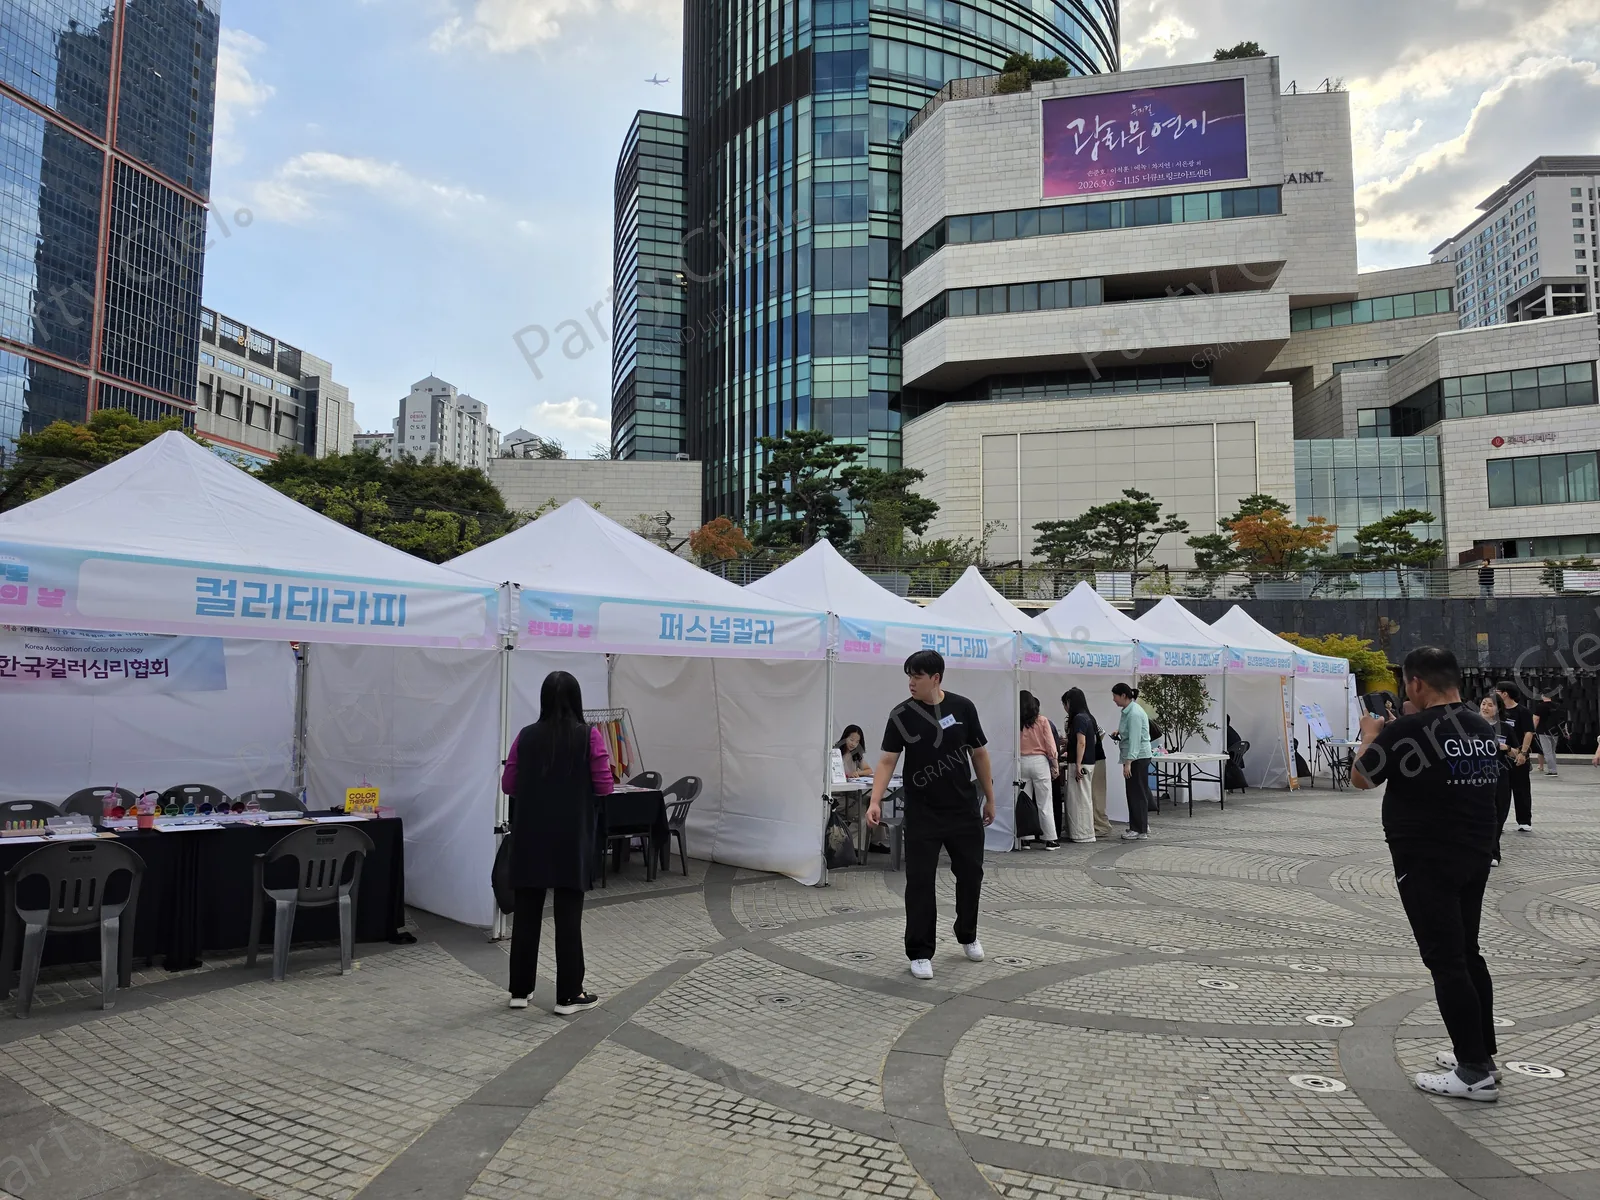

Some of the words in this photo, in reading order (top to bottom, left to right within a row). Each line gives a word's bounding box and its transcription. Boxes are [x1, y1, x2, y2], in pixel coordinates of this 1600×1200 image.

[1130, 103, 1156, 117] 뮤지컬
[1078, 179, 1115, 190] 2026.9.6
[1124, 175, 1140, 185] 11.15
[196, 576, 407, 628] 컬러테라피
[549, 607, 574, 621] 구로
[528, 620, 574, 637] 청년의
[659, 612, 775, 645] 퍼스널컬러
[24, 643, 44, 651] Korea
[45, 645, 82, 653] Association
[109, 646, 144, 654] Psychology
[921, 633, 988, 659] 캘리그라피
[0, 655, 169, 679] 한국컬러심리협회
[1067, 652, 1086, 668] 100g
[1164, 651, 1192, 667] 인생네컷
[1444, 738, 1497, 757] GURO
[348, 792, 377, 800] COLOR
